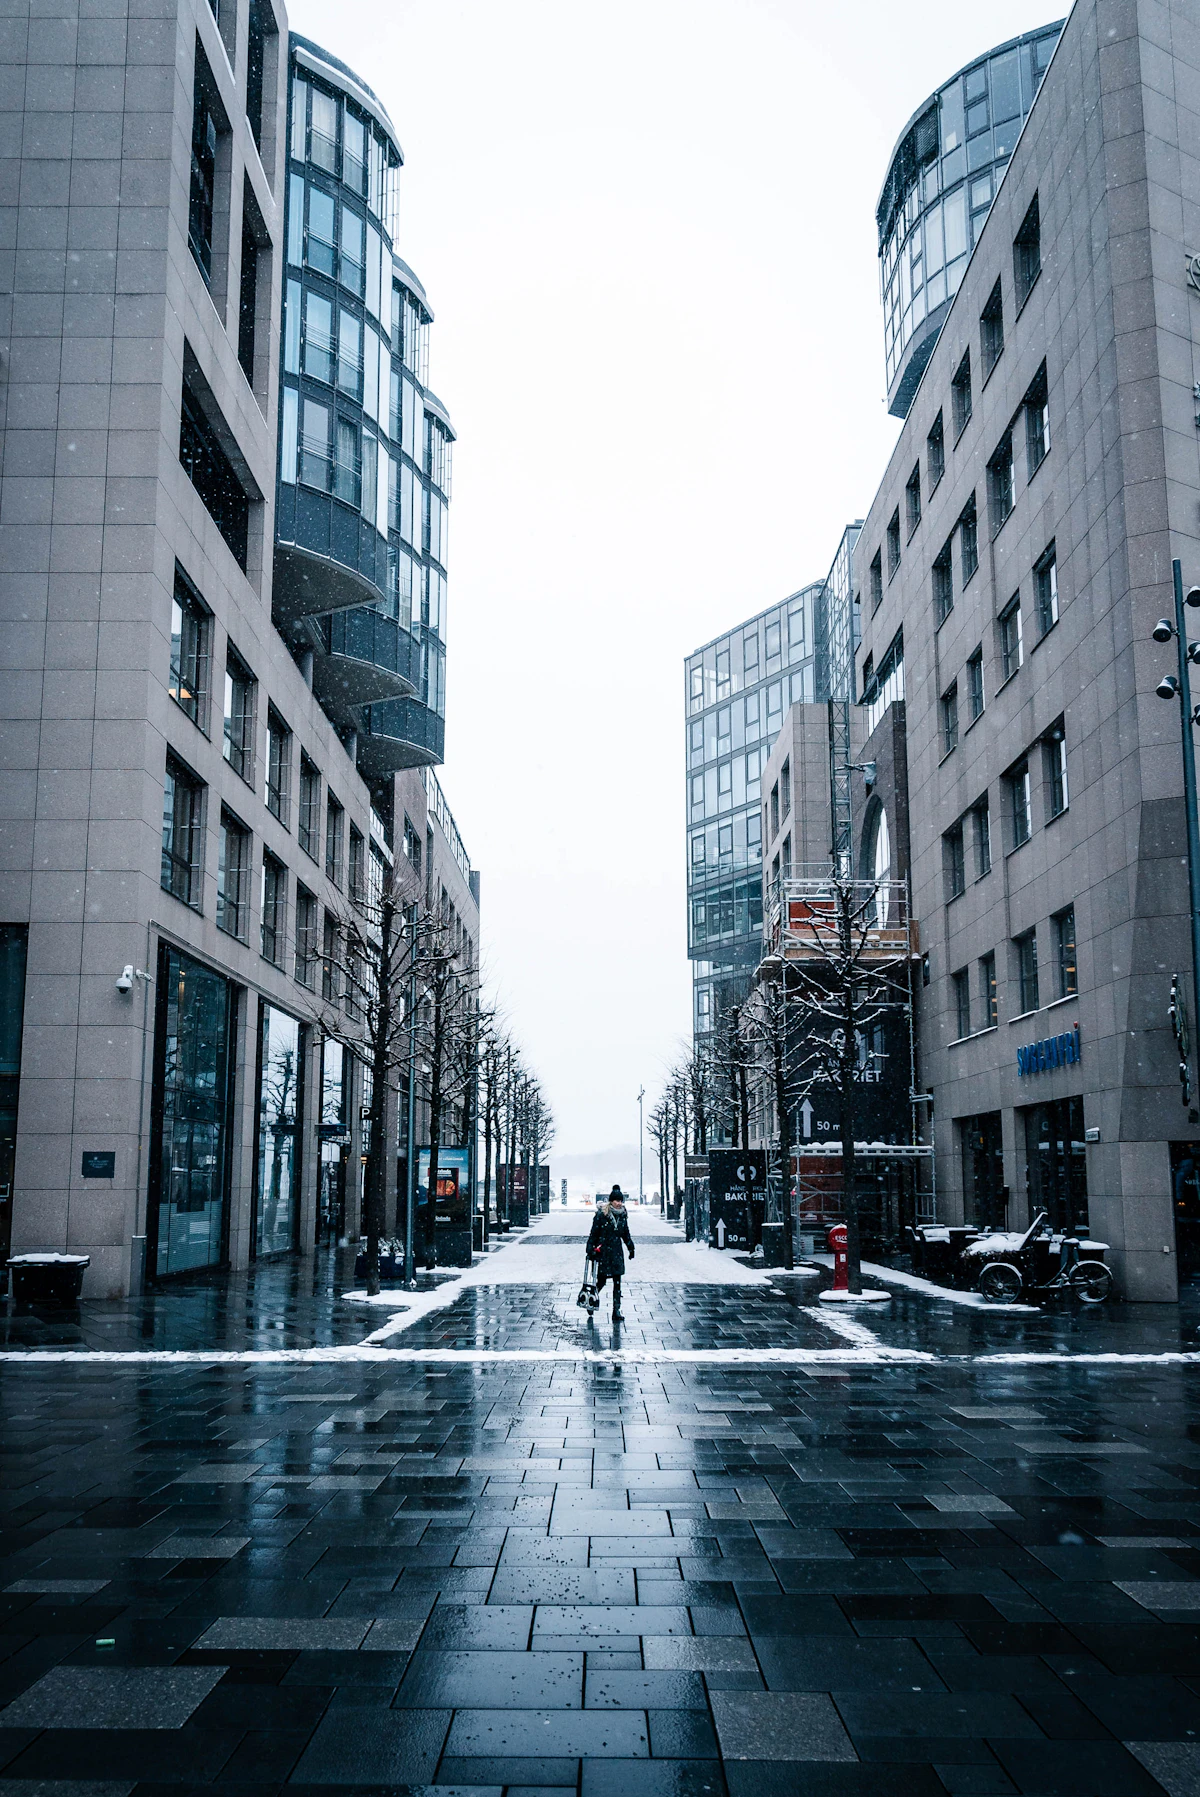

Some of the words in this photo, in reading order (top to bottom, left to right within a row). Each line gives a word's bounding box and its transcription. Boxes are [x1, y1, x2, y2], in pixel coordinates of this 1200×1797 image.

[1017, 1021, 1080, 1076] SORGENFRI
[812, 1070, 882, 1082] BAKRIET
[362, 1108, 371, 1119] P
[816, 1121, 831, 1130] 50
[728, 1234, 738, 1242] 50
